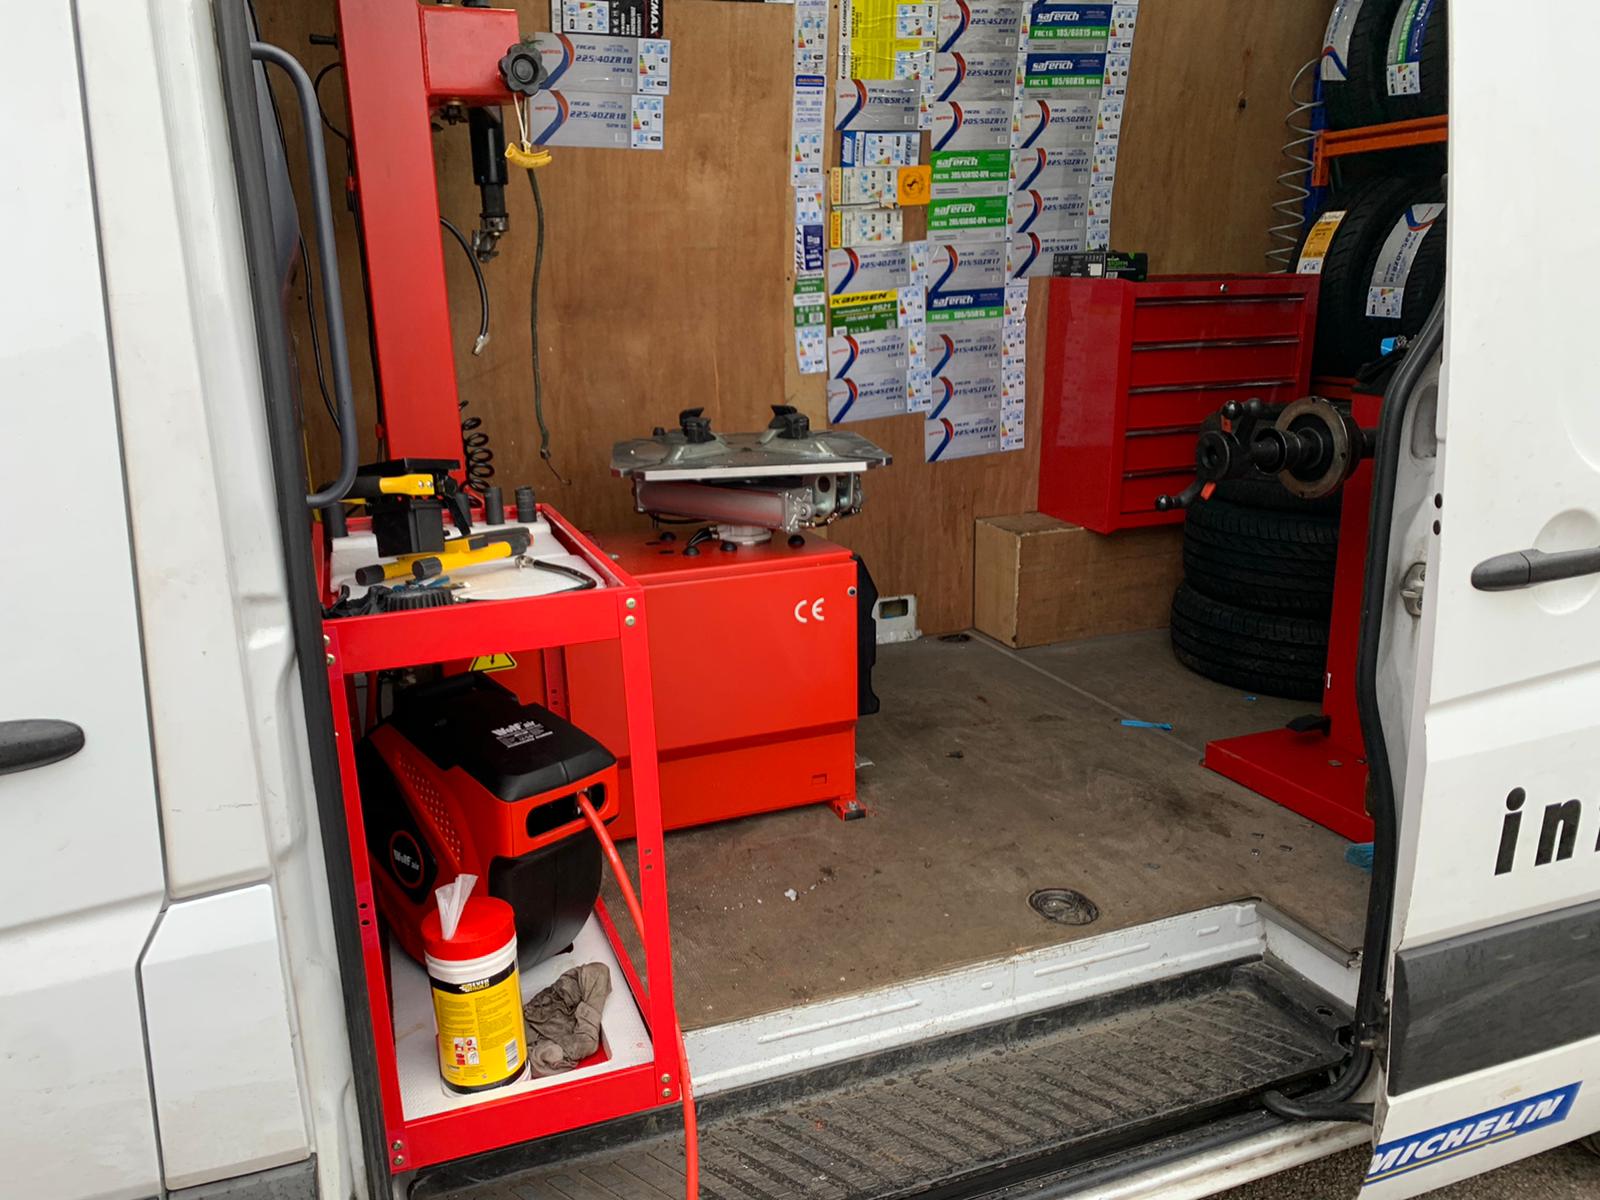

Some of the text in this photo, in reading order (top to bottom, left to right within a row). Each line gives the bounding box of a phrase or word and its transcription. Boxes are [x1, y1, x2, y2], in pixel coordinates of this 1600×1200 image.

[1036, 11, 1079, 22] saferich
[1032, 60, 1073, 71] saferich
[936, 156, 978, 168] saferich
[933, 203, 976, 216] saferich
[1494, 786, 1600, 876] in
[1368, 1094, 1566, 1175] MICHELIN
